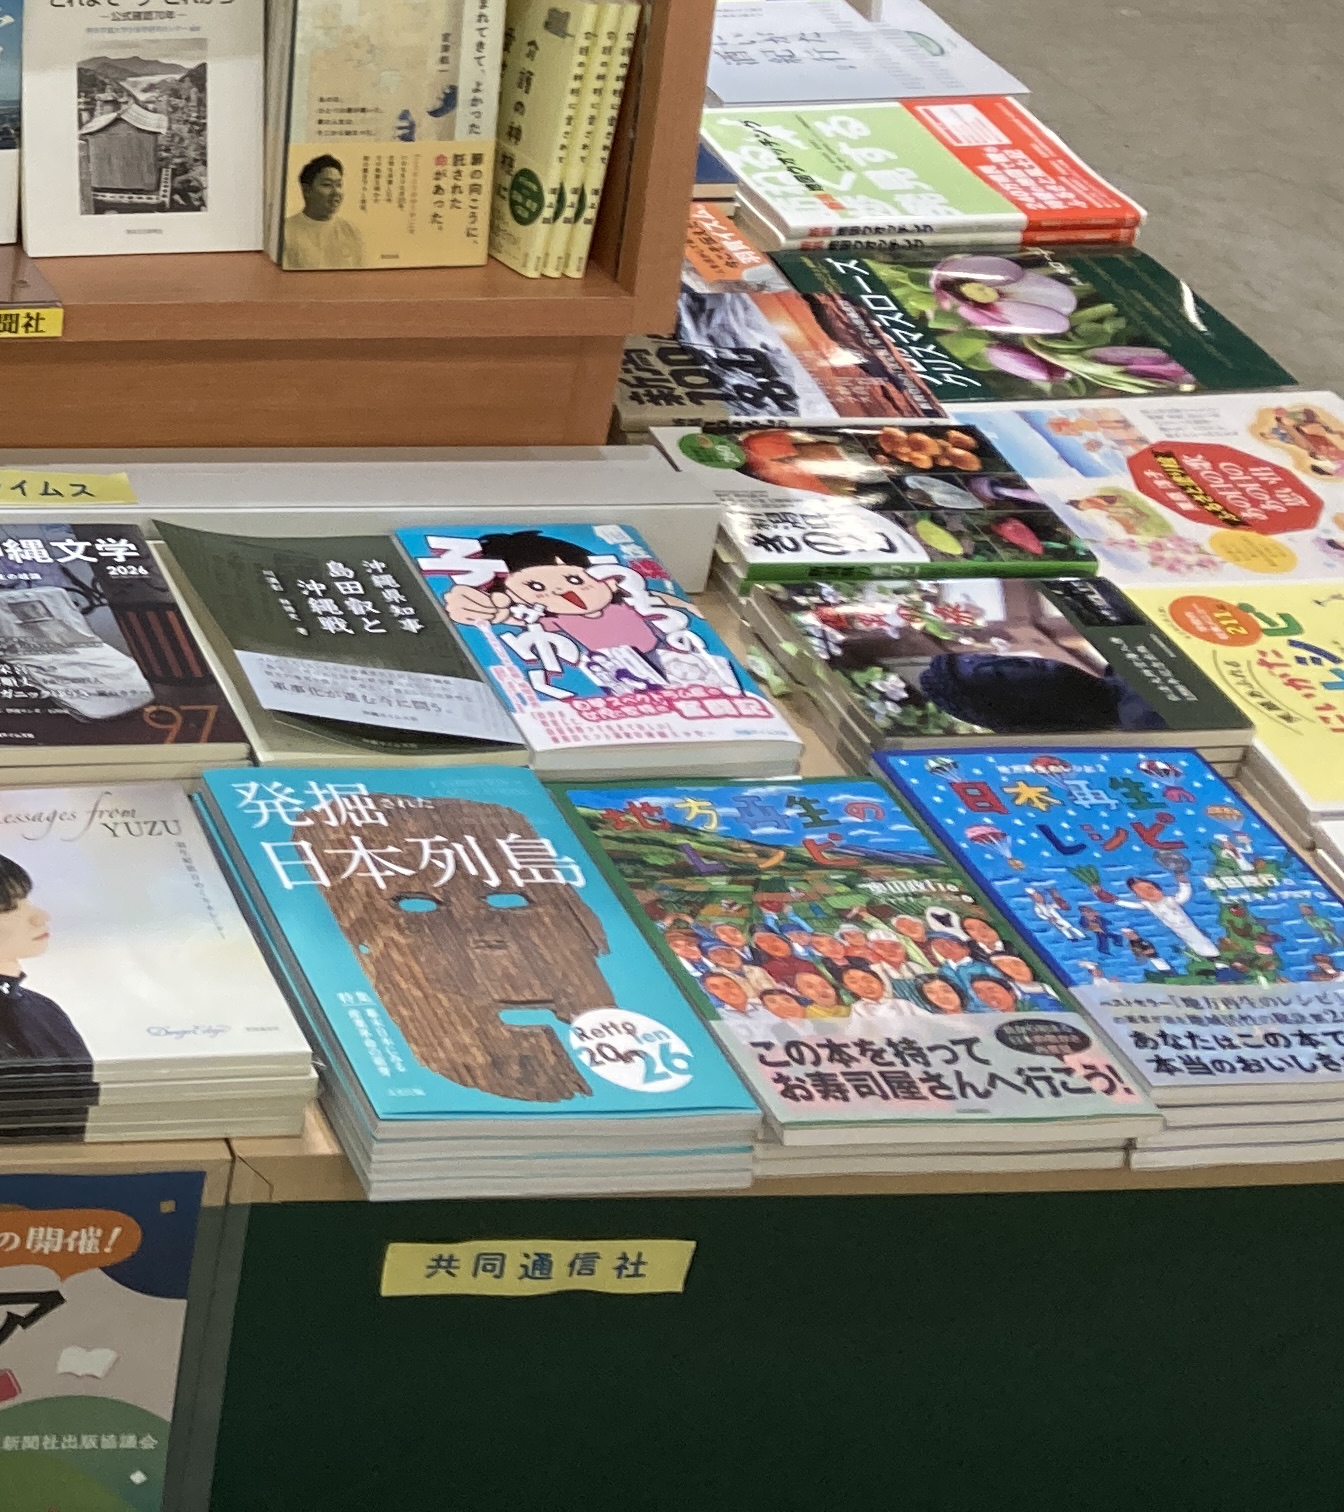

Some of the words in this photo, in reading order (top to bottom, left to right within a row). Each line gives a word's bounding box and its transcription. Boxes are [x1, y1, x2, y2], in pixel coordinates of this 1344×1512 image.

[297, 578, 355, 636] 沖縄戦
[362, 558, 426, 635] 沖縄県知事
[141, 704, 219, 745] 97
[233, 781, 391, 829] 発掘
[381, 797, 435, 811] された
[602, 795, 886, 835] 地方再生の
[948, 777, 1200, 814] 日本再生の
[73, 790, 138, 842] from
[102, 819, 183, 838] YUZU
[680, 834, 859, 874] レシピ
[1045, 823, 1187, 854] レシピ
[260, 835, 588, 891] 日本列島
[757, 1037, 991, 1069] この本を持って
[778, 1064, 1126, 1105] お寿司屋さんへ行こう!
[425, 1252, 648, 1280] 共同通信社
